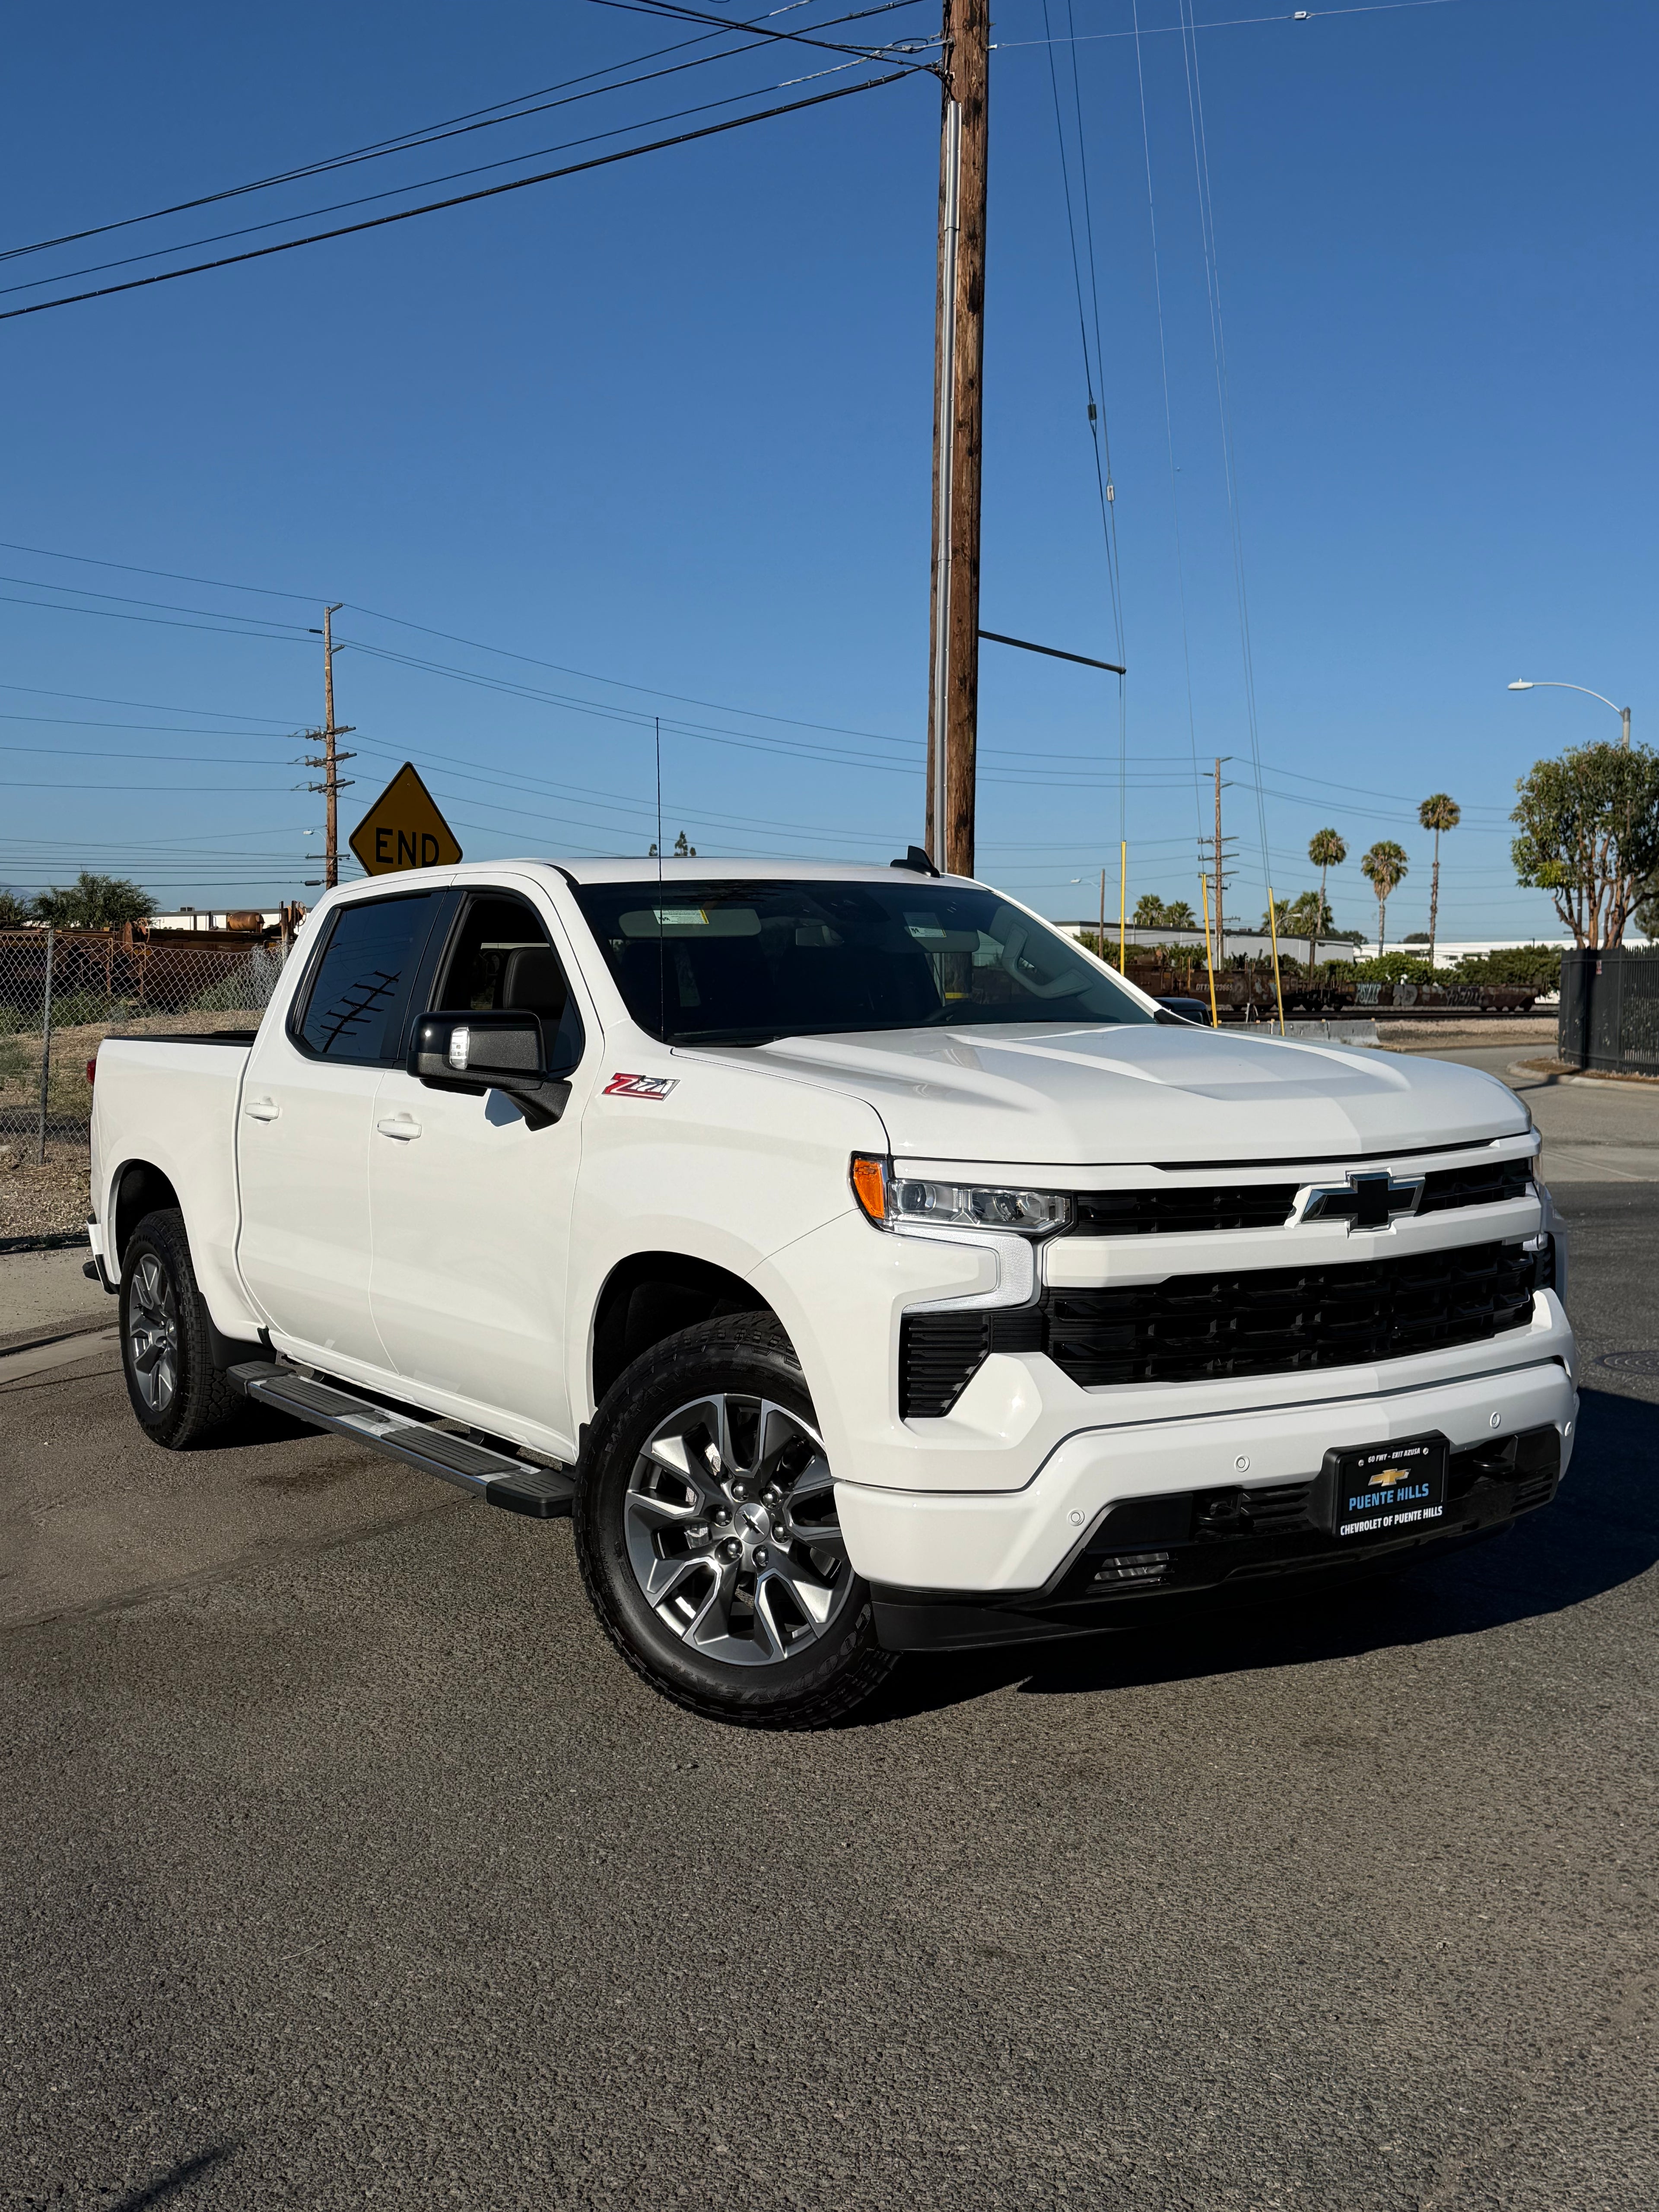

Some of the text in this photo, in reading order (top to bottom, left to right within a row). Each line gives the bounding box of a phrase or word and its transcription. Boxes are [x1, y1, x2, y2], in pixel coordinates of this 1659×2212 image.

[375, 827, 439, 868] END
[1376, 1453, 1388, 1462] FWY
[1392, 1451, 1404, 1459] EXIT
[1403, 1447, 1421, 1457] AZUSA
[1349, 1483, 1429, 1511] PUENTE HILLS
[1340, 1506, 1443, 1536] CHEVROLET OF PUENTE HILLS
